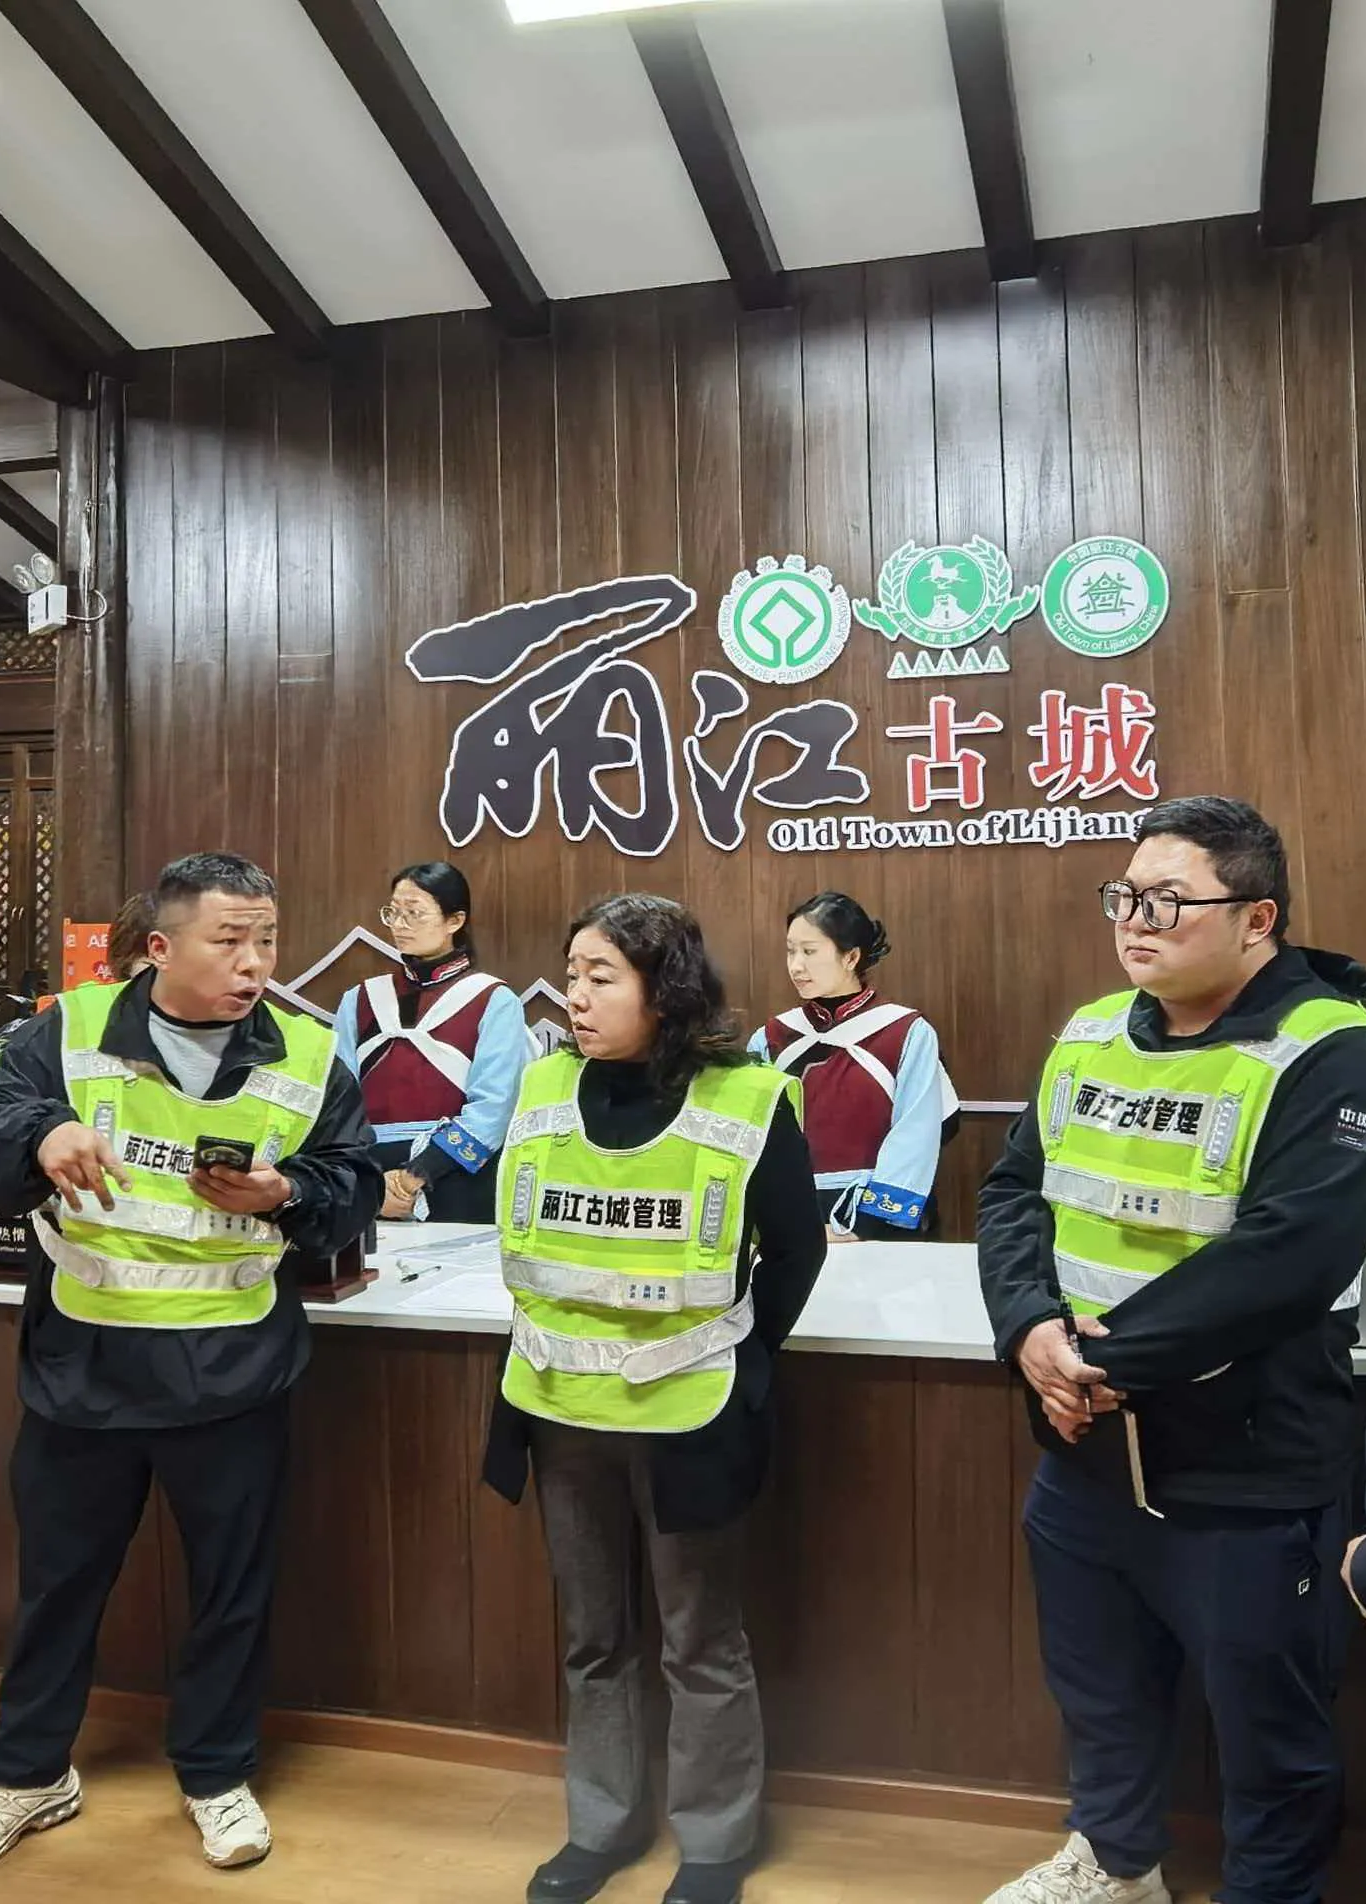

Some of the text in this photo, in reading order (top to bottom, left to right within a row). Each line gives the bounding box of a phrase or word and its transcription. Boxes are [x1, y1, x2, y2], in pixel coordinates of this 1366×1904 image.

[770, 818, 835, 849] Old
[845, 818, 946, 848] Town
[961, 812, 1003, 843] of
[540, 1188, 683, 1230] 丽江古城管理
